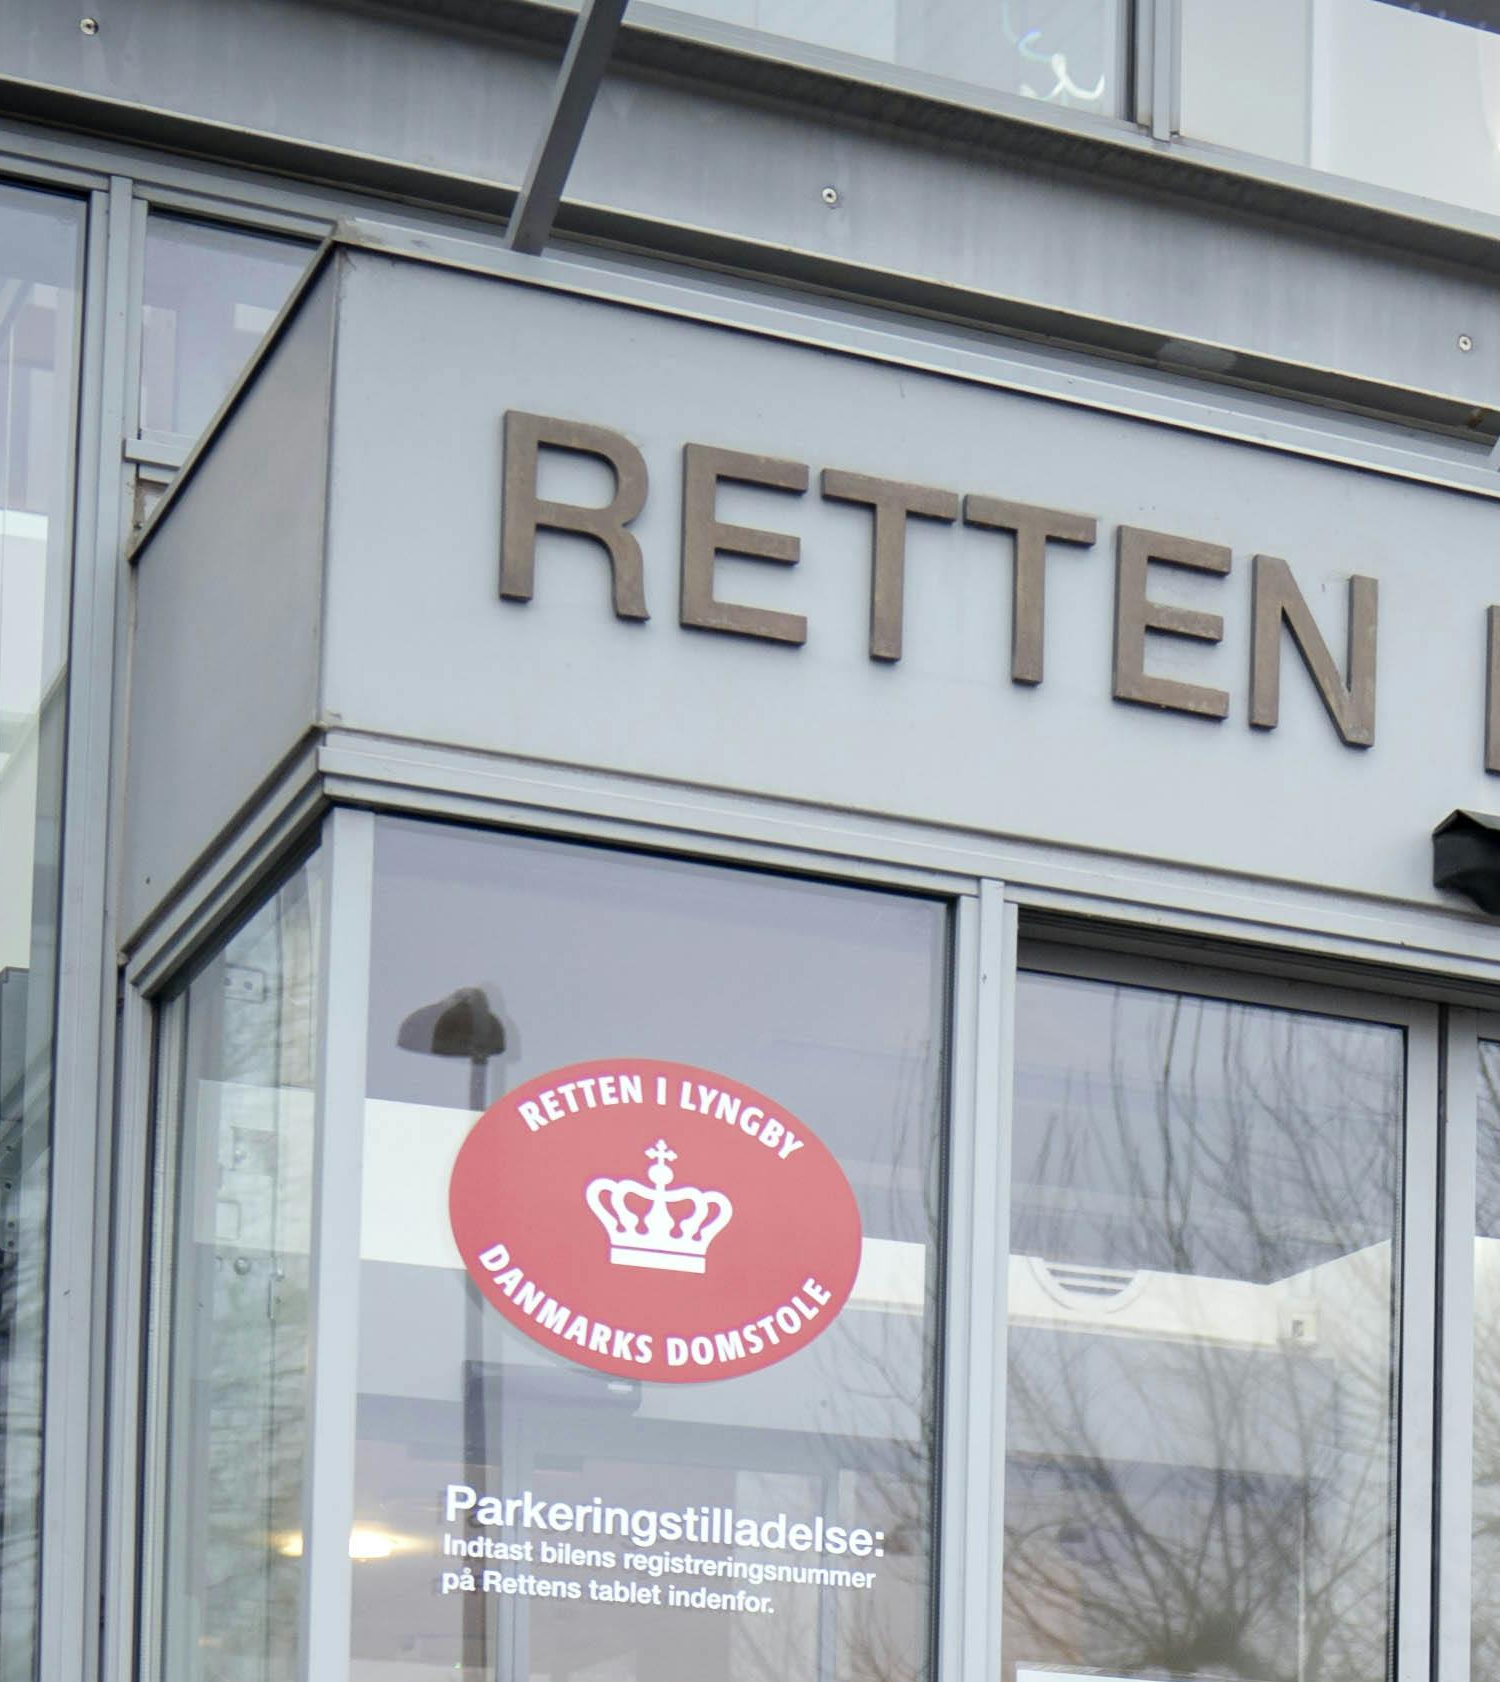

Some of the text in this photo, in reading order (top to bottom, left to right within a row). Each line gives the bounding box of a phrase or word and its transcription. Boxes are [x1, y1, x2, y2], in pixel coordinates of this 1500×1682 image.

[500, 410, 1379, 750] RETTEN
[517, 1074, 805, 1160] RETTEN I LYNGBY
[478, 1243, 832, 1367] DANMARKS DOMSTOLE
[445, 1484, 885, 1557] Parkeringstilladelse:
[441, 1567, 775, 1615] på Rettens tablet indenfor.
[442, 1533, 876, 1589] Indtast bilens registreringsnummer
